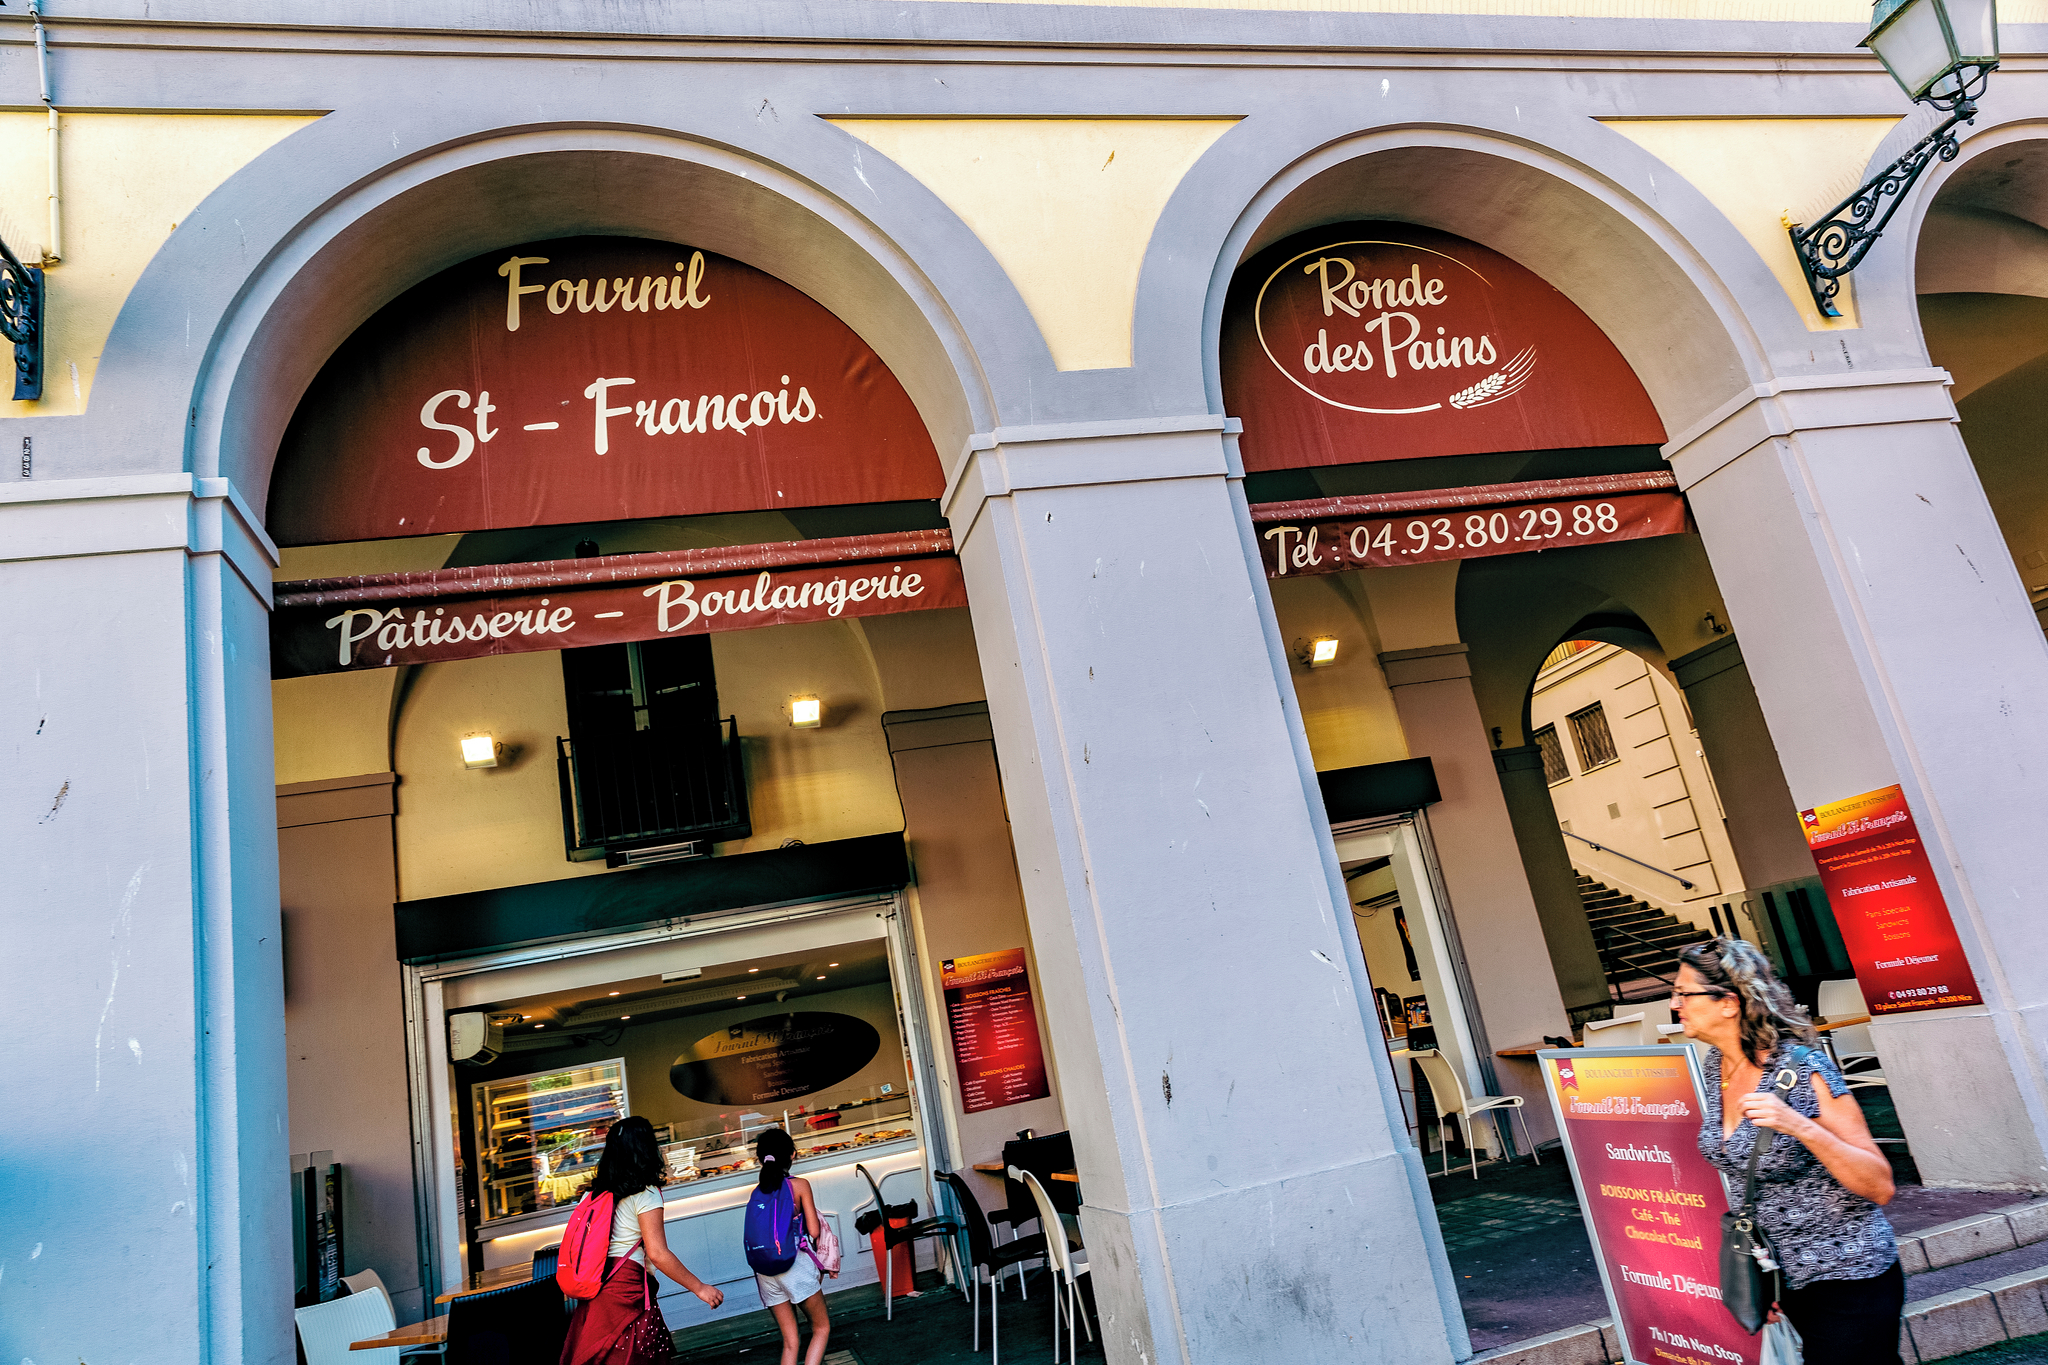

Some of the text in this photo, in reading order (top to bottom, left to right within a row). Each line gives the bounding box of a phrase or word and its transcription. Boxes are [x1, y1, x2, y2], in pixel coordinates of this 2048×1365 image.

[499, 251, 711, 332] Fournil
[1304, 257, 1448, 317] Ronde
[1304, 311, 1498, 378] des Pains
[416, 389, 500, 470] St
[583, 374, 818, 456] François
[1264, 524, 1322, 576] Tél
[1349, 502, 1619, 560] 04.93.80.29.88
[325, 599, 577, 666] Pâtisserie
[643, 564, 926, 633] Boulangerie
[1842, 874, 1917, 898] Fabrication Artisanale
[1874, 954, 1905, 970] Formule
[1605, 1142, 1671, 1164] Sandwichs
[1600, 1183, 1706, 1208] BOISSONS FRAÎCHES
[1631, 1207, 1653, 1223] Café
[1662, 1211, 1681, 1227] Thé
[1625, 1226, 1703, 1250] Chocolat Chaud
[1620, 1264, 1724, 1301] Formule Déjeun
[1648, 1326, 1665, 1342] 7h
[1668, 1332, 1691, 1350] 20h
[1689, 1336, 1715, 1357] Non
[1713, 1344, 1744, 1365] Stop
